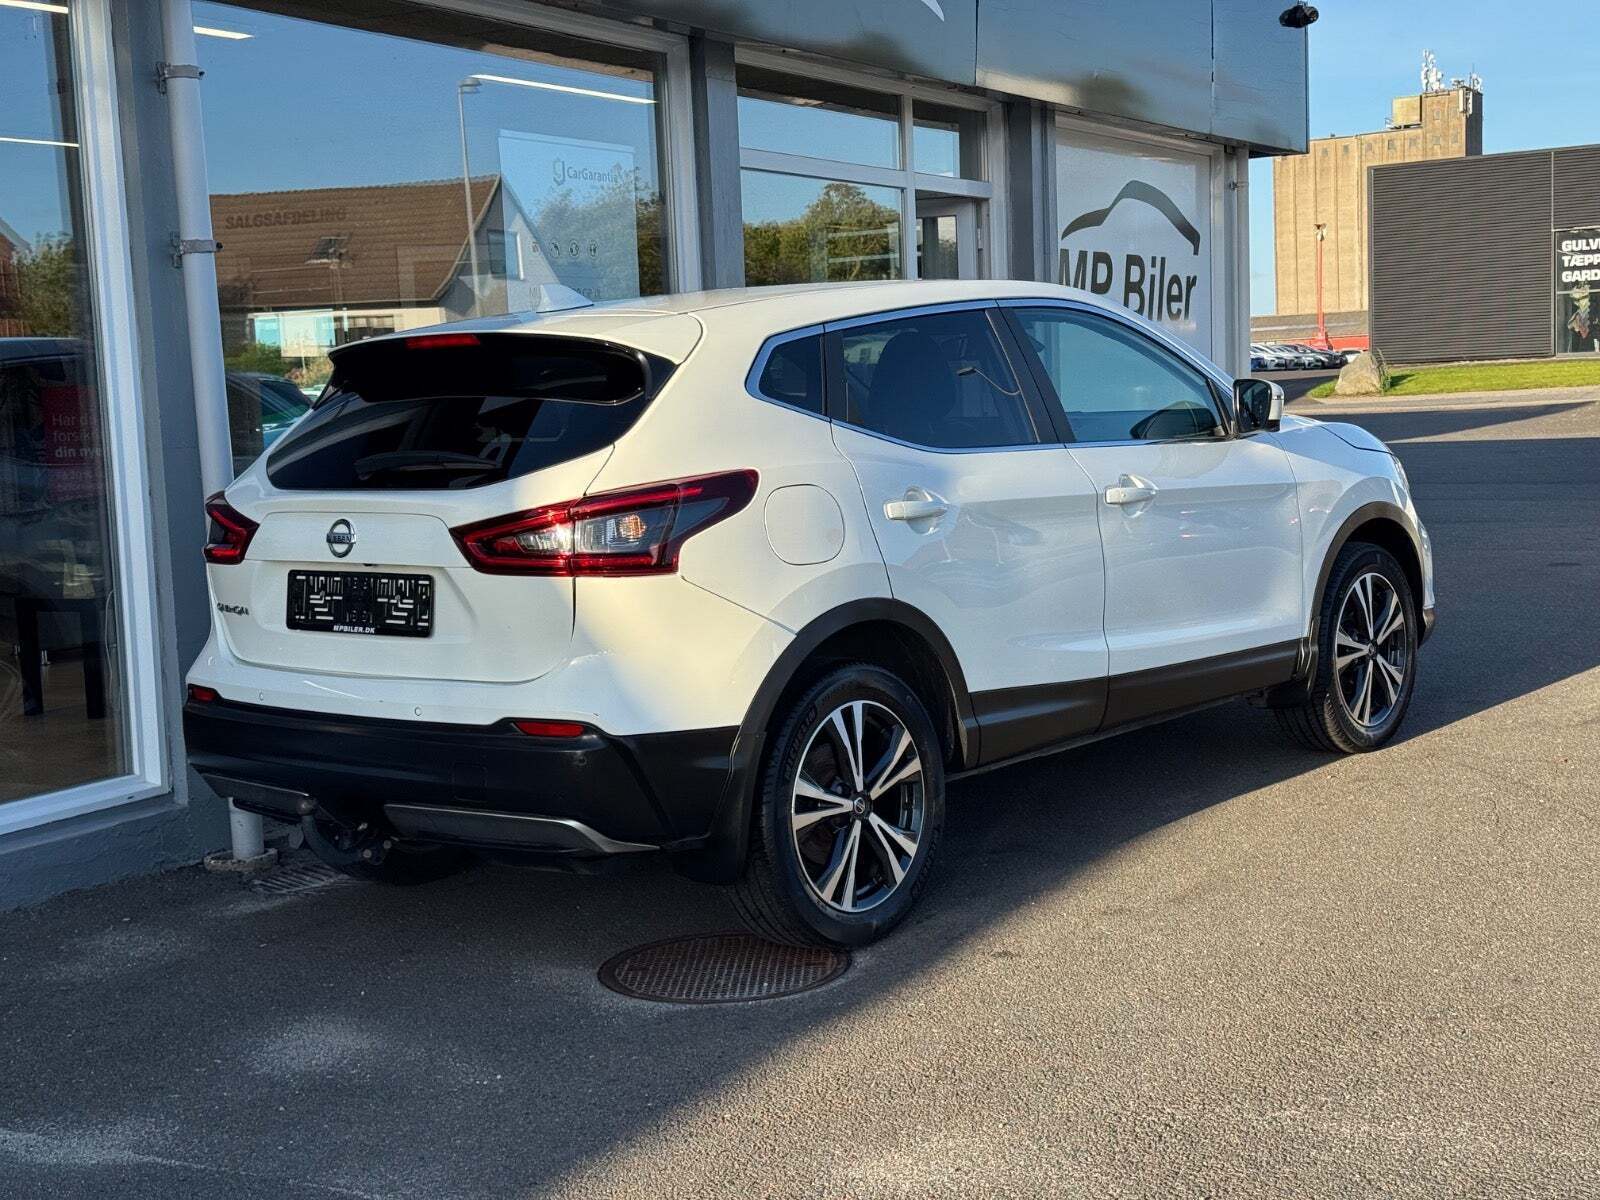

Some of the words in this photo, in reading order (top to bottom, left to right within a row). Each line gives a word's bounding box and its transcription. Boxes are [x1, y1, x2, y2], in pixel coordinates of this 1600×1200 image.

[225, 206, 347, 230] SALGSAFDELING
[1058, 248, 1114, 295] MP
[1123, 253, 1198, 322] Biler
[55, 447, 76, 459] din
[333, 624, 376, 634] MPBILER.DK
